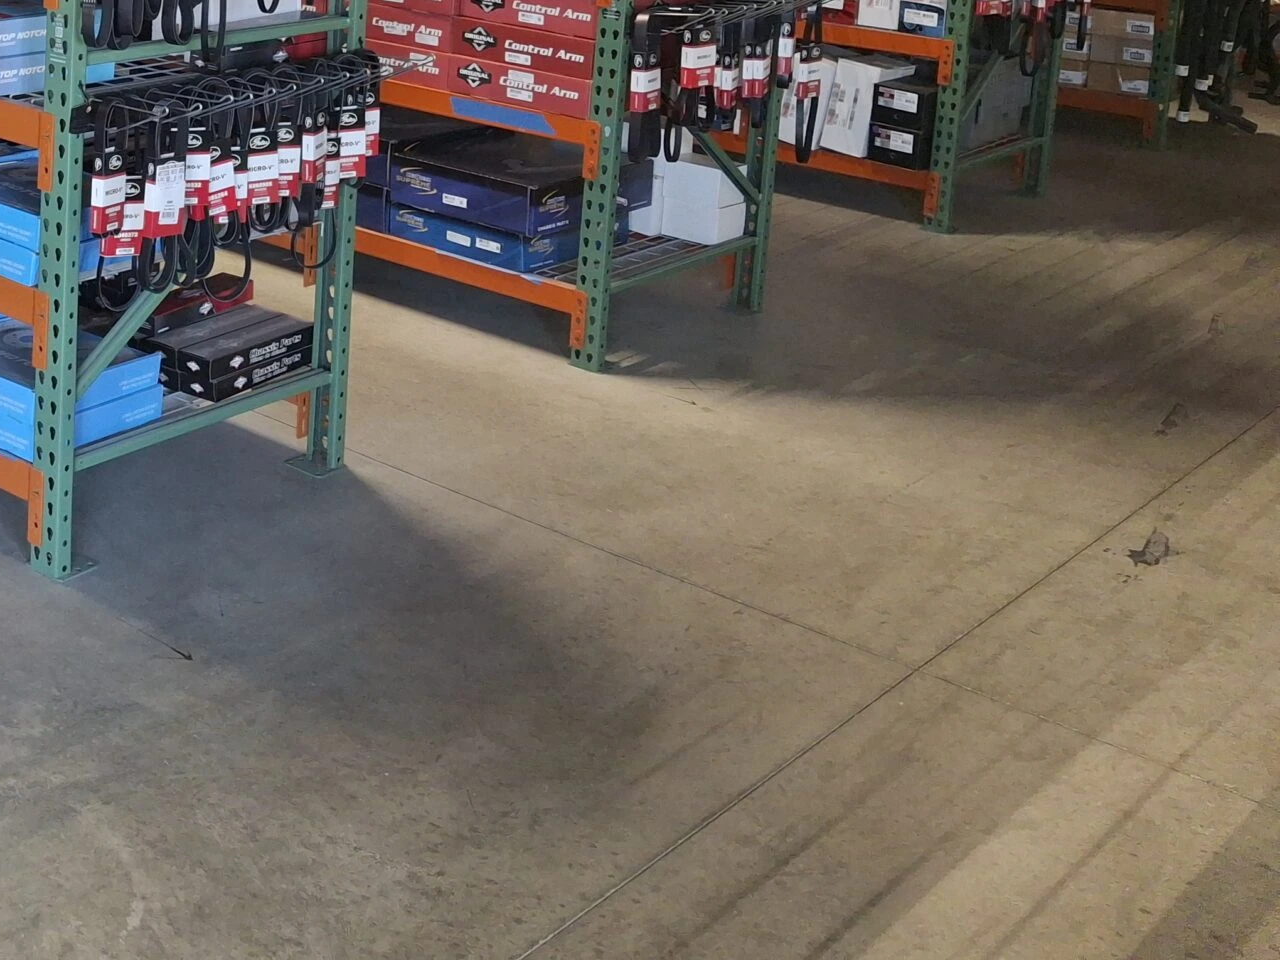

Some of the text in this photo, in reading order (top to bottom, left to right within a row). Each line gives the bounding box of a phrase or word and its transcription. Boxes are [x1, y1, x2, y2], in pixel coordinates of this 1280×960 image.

[512, 0, 592, 22] Control Arm
[17, 28, 47, 39] NOTCH
[372, 16, 443, 37] Control Arm
[464, 33, 495, 44] ORIGINAL
[504, 39, 585, 64] Control Arm
[0, 70, 18, 80] TOP
[459, 69, 489, 80] ORIGINAL
[499, 76, 579, 100] Control Arm
